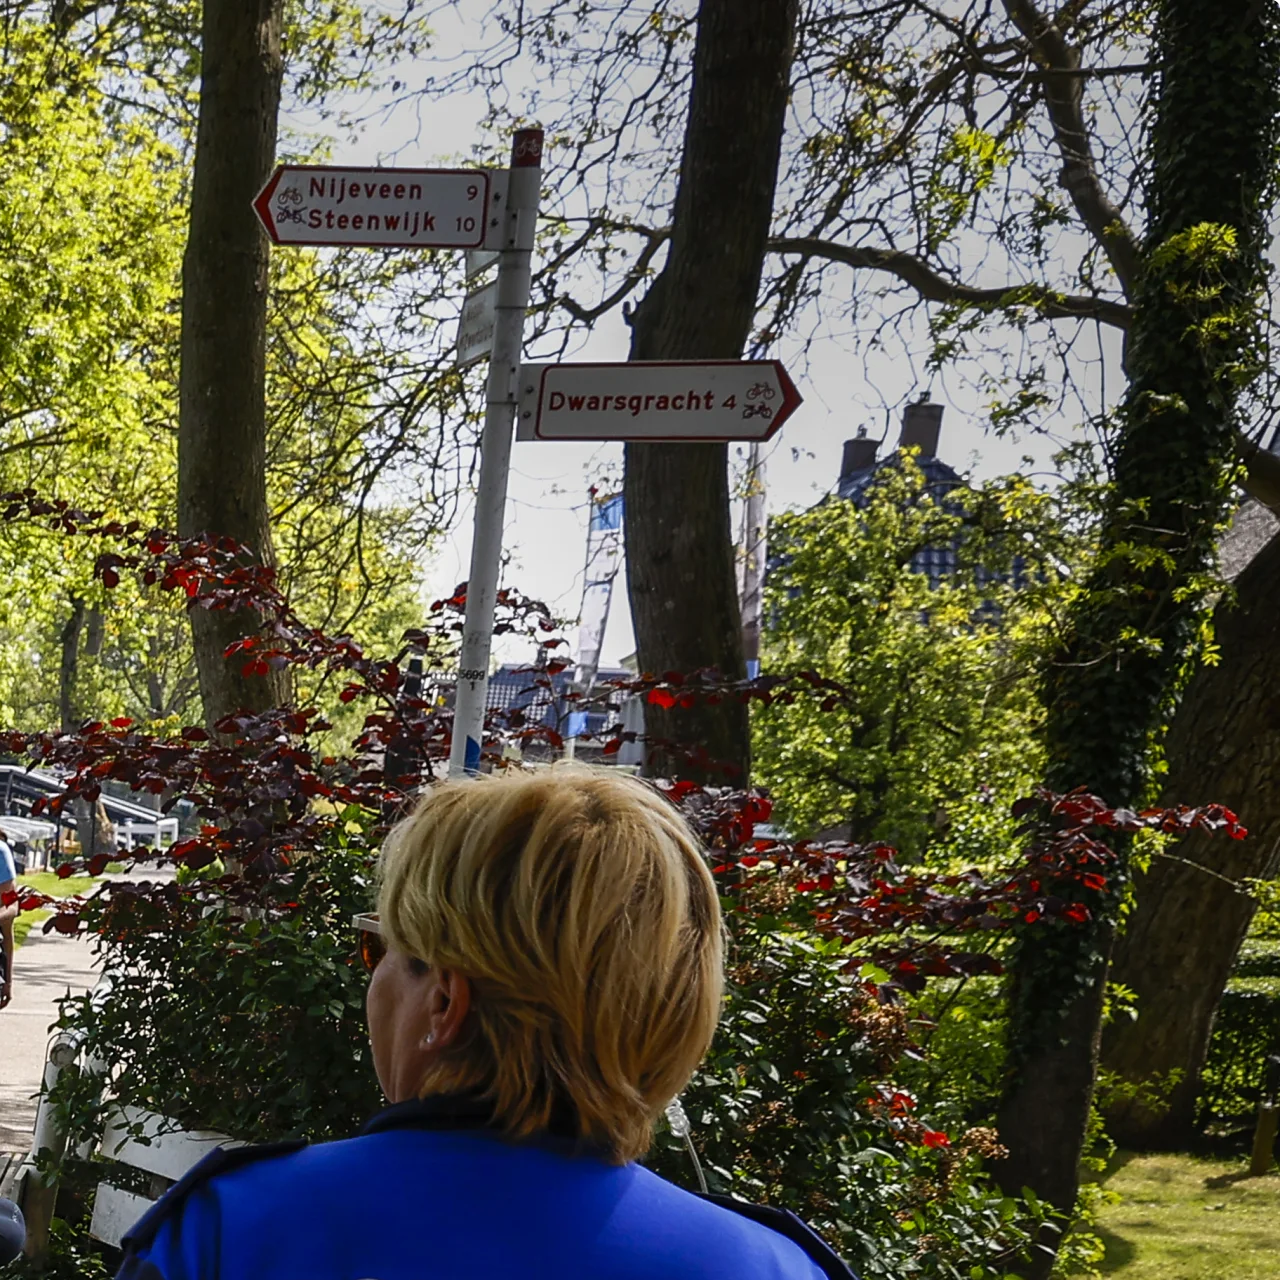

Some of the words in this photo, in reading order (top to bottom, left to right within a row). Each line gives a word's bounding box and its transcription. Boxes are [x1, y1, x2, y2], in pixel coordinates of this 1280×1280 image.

[309, 176, 423, 204] Nijeveen
[466, 185, 479, 201] 9
[307, 208, 436, 238] Steenwijk
[456, 217, 476, 233] 10
[548, 389, 715, 418] Dwarsgracht
[722, 394, 738, 411] 4
